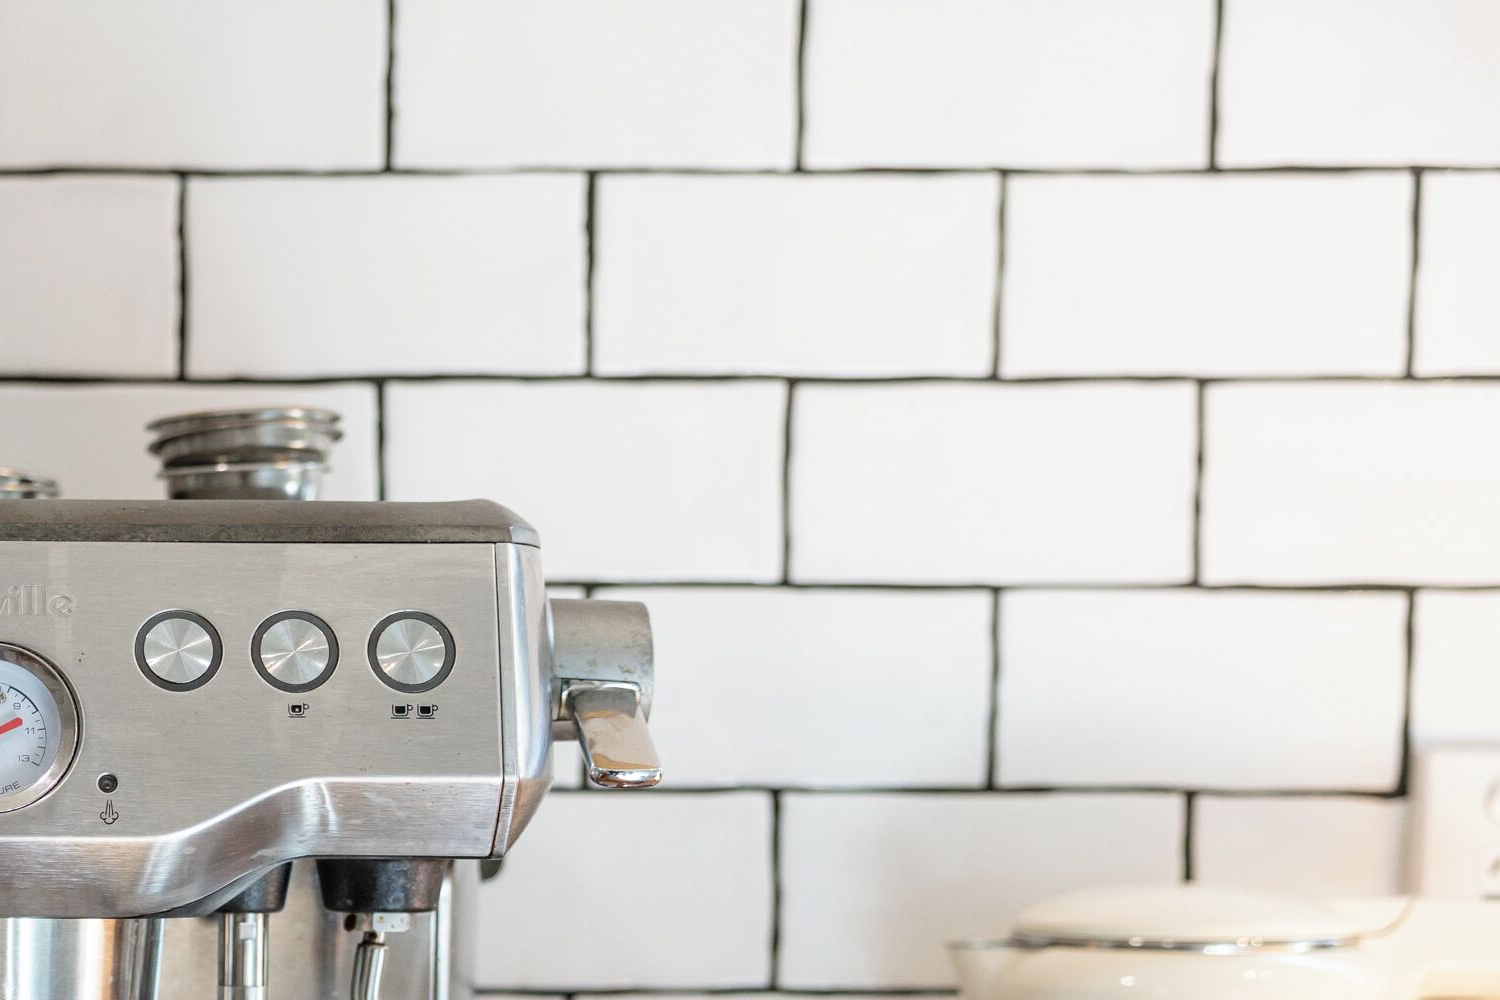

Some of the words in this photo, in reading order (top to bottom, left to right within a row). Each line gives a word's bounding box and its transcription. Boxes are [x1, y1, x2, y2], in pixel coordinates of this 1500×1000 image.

[13, 702, 21, 710] 9
[25, 727, 35, 735] 11
[18, 754, 30, 762] 13
